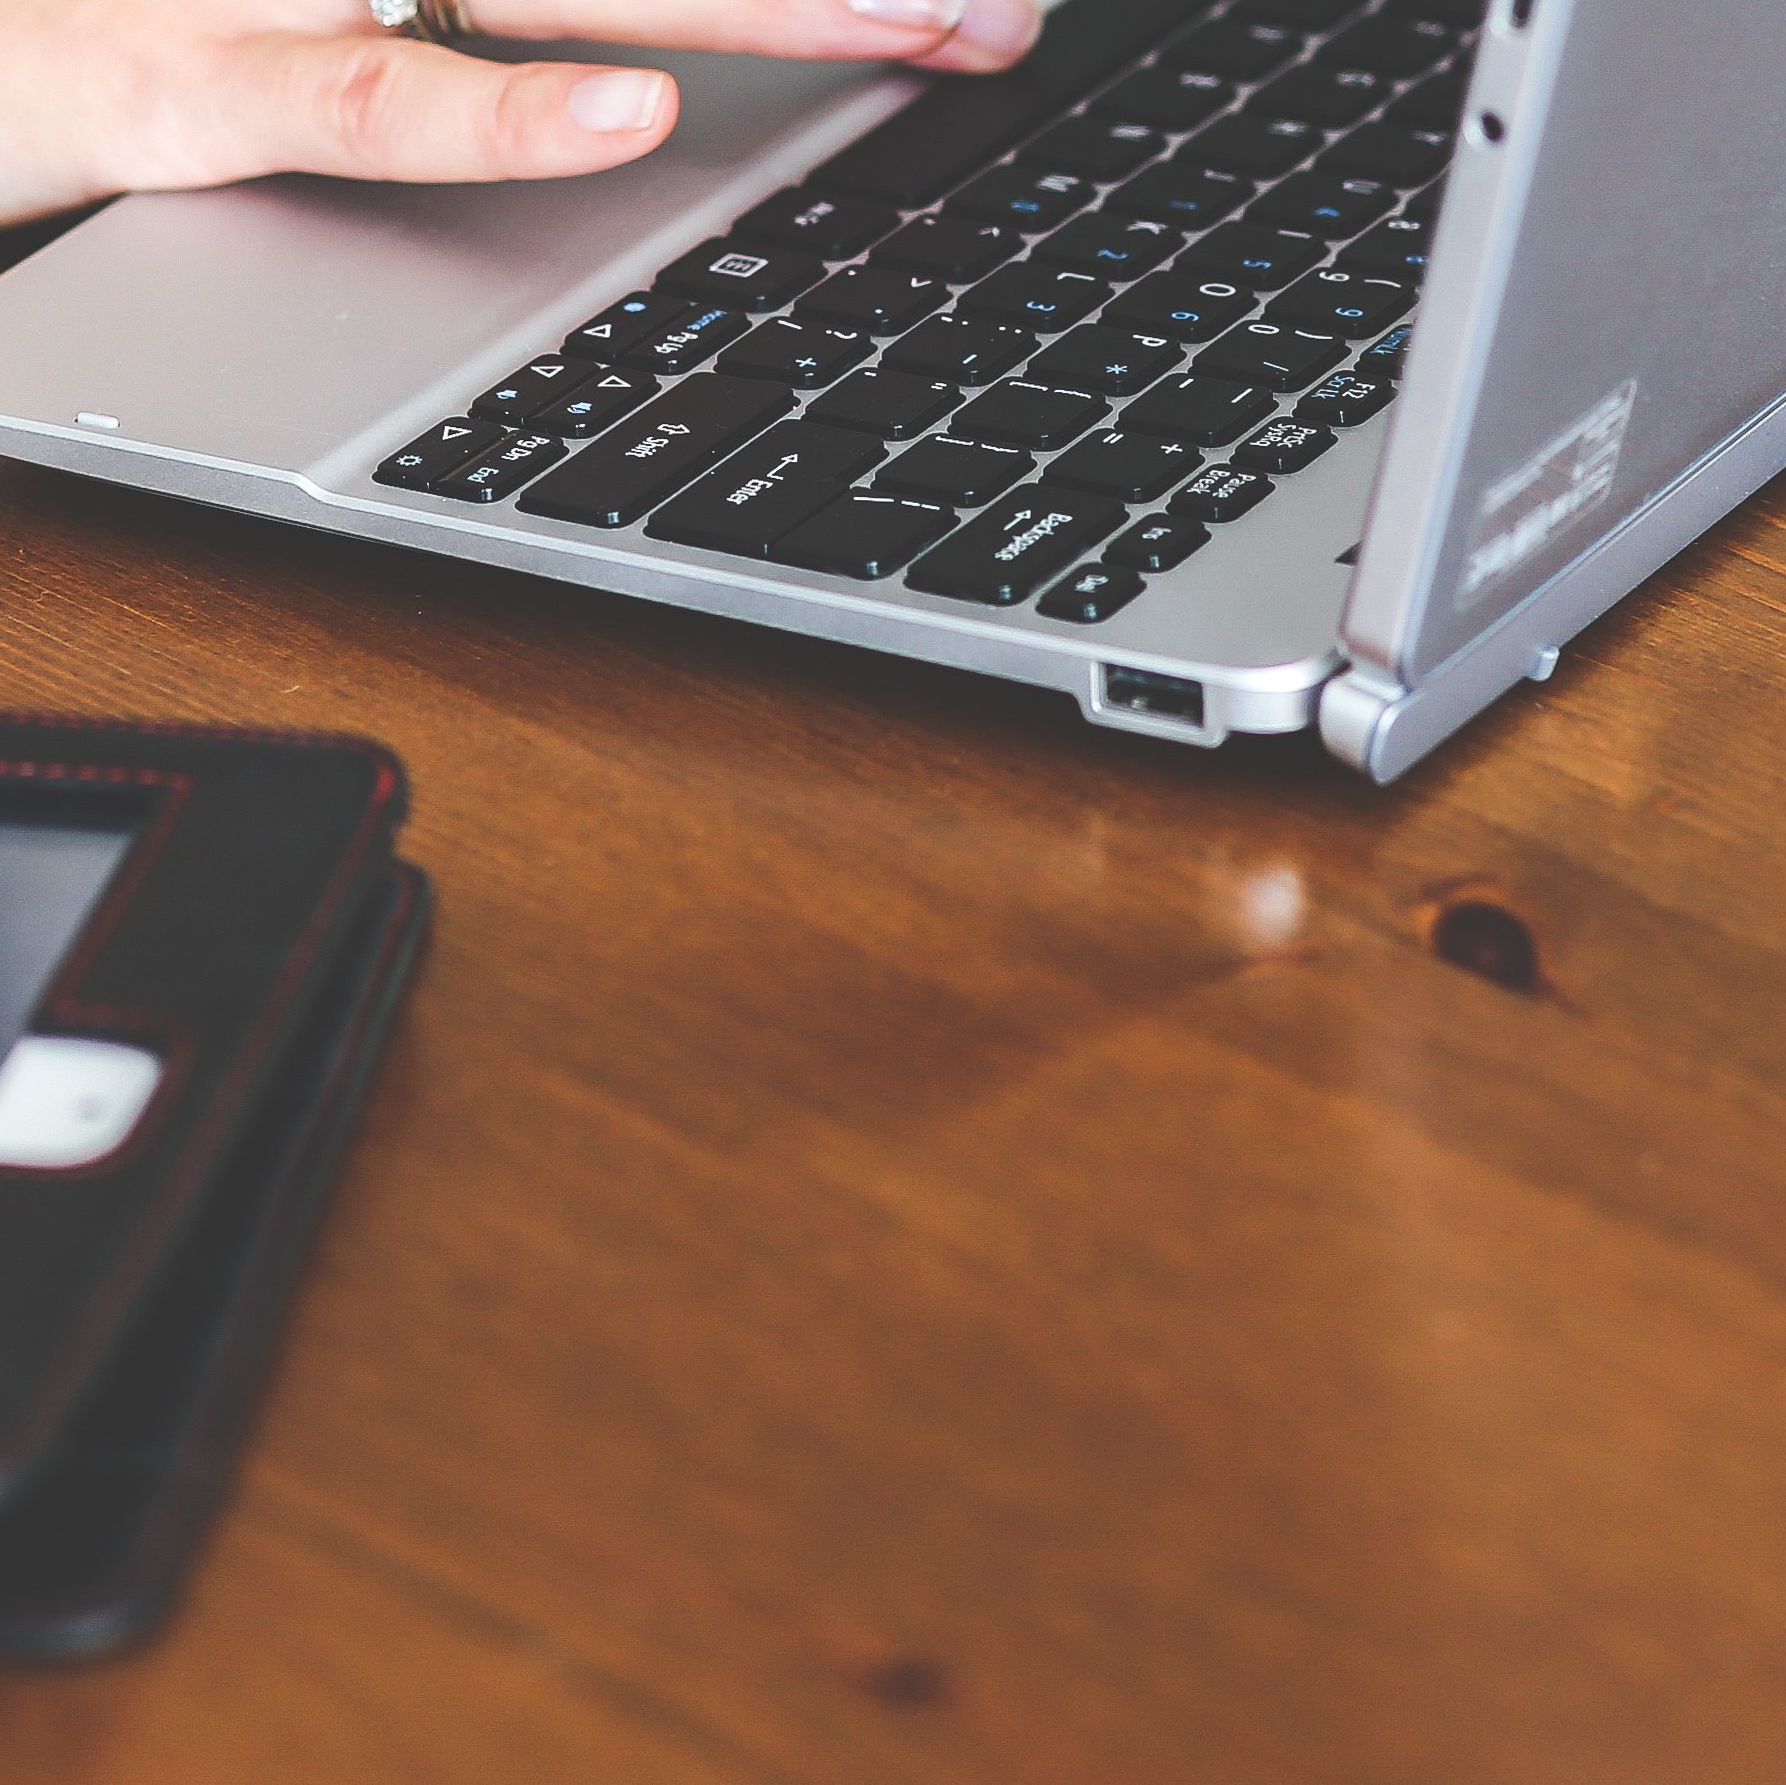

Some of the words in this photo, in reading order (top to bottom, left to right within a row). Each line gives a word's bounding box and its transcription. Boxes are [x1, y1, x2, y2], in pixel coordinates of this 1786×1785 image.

[1127, 220, 1168, 235] K
[1056, 272, 1096, 281] L
[1319, 271, 1350, 282] 9
[1199, 282, 1237, 297] O
[1026, 301, 1056, 312] 3
[1335, 307, 1364, 317] 9
[1171, 311, 1199, 322] 6
[825, 329, 858, 340] ?
[1247, 324, 1280, 335] 0
[653, 338, 683, 354] Up
[666, 332, 699, 345] Pg
[1132, 334, 1168, 347] P
[1325, 375, 1355, 387] Scr
[1311, 384, 1339, 399] Lk
[1342, 382, 1376, 399] F12
[1249, 422, 1297, 447] SysRq
[1276, 427, 1318, 448] PrtSc
[517, 435, 551, 450] Pg
[624, 436, 670, 458] Shift
[500, 446, 534, 462] Dn
[466, 467, 500, 484] End
[1186, 469, 1231, 494] Break
[726, 478, 774, 505] Enter
[1212, 472, 1257, 498] Pause
[994, 512, 1074, 561] Backspace
